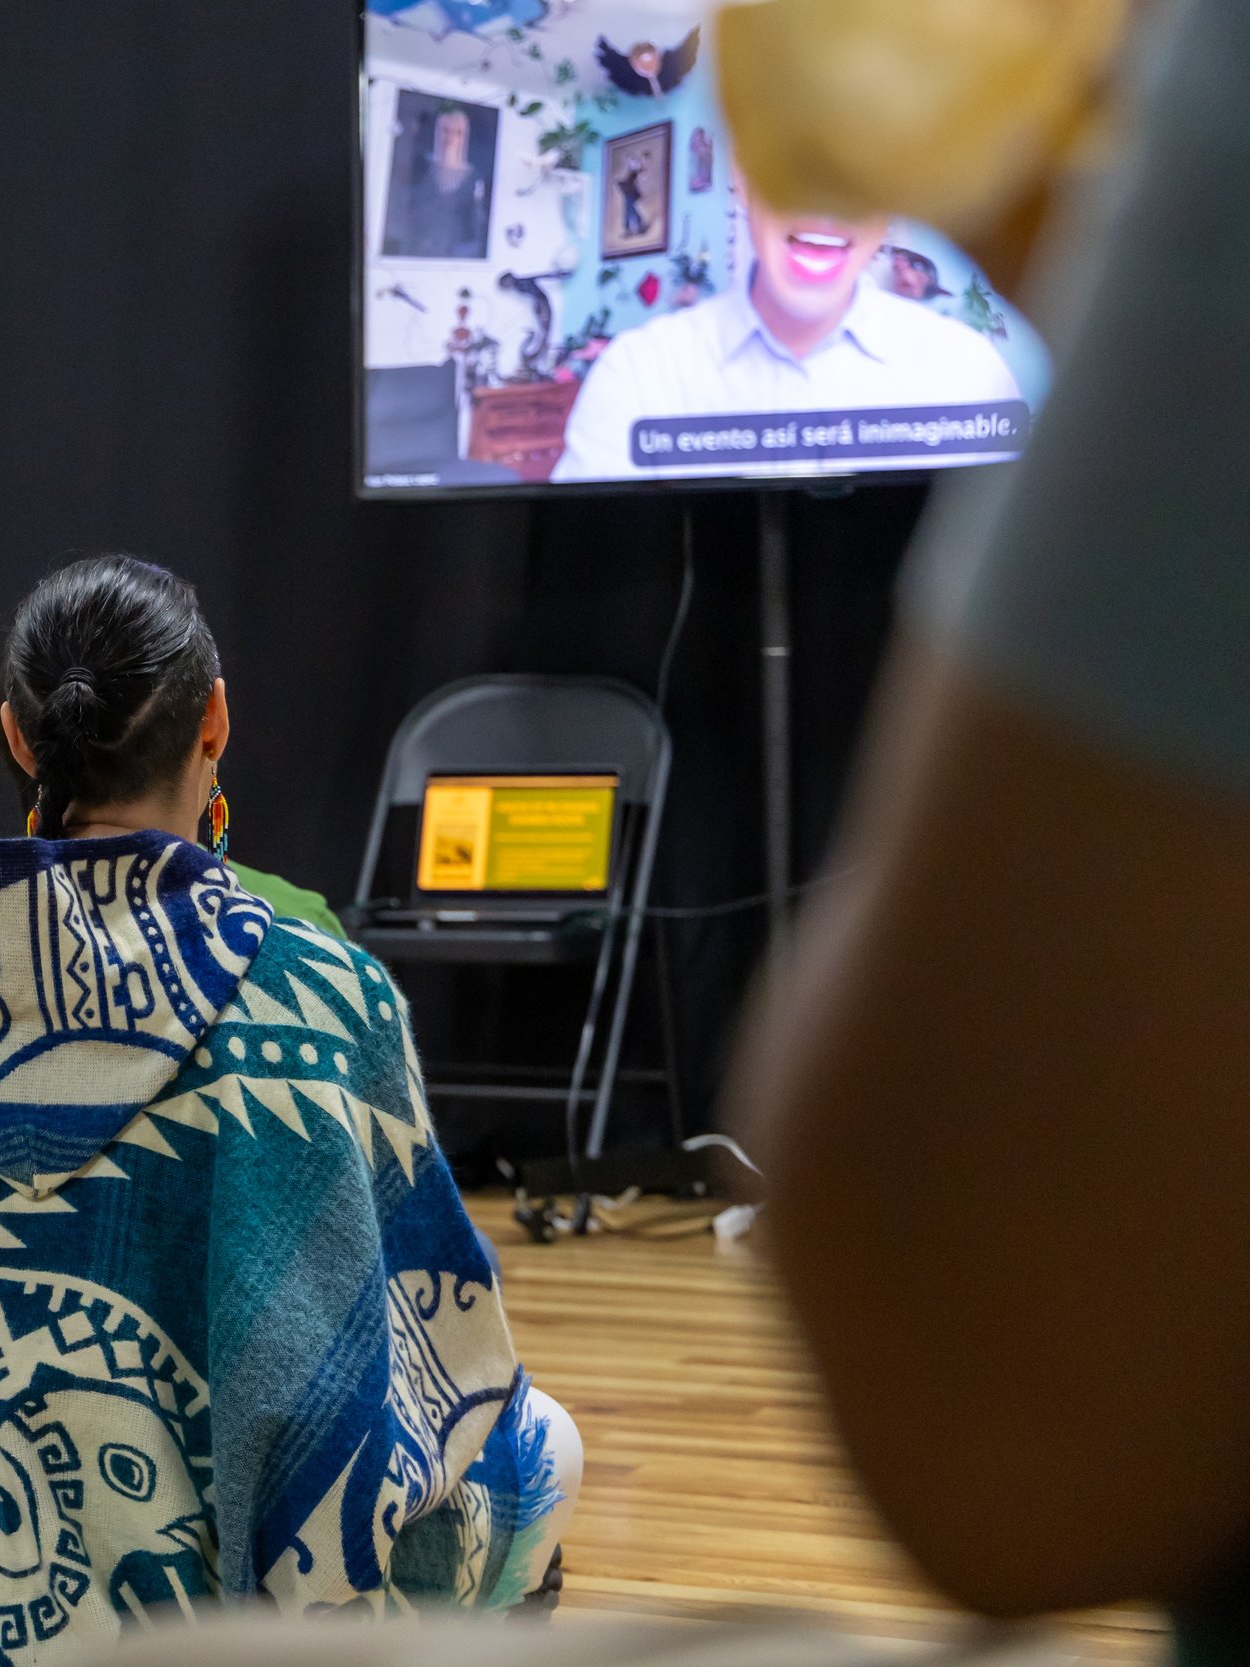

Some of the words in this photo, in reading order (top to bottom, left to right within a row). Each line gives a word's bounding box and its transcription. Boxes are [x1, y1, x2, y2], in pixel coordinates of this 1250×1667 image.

[638, 428, 673, 454] Un
[677, 426, 757, 452] evento
[761, 421, 798, 449] así
[801, 418, 854, 447] será
[857, 411, 1018, 447] inimaginable.
